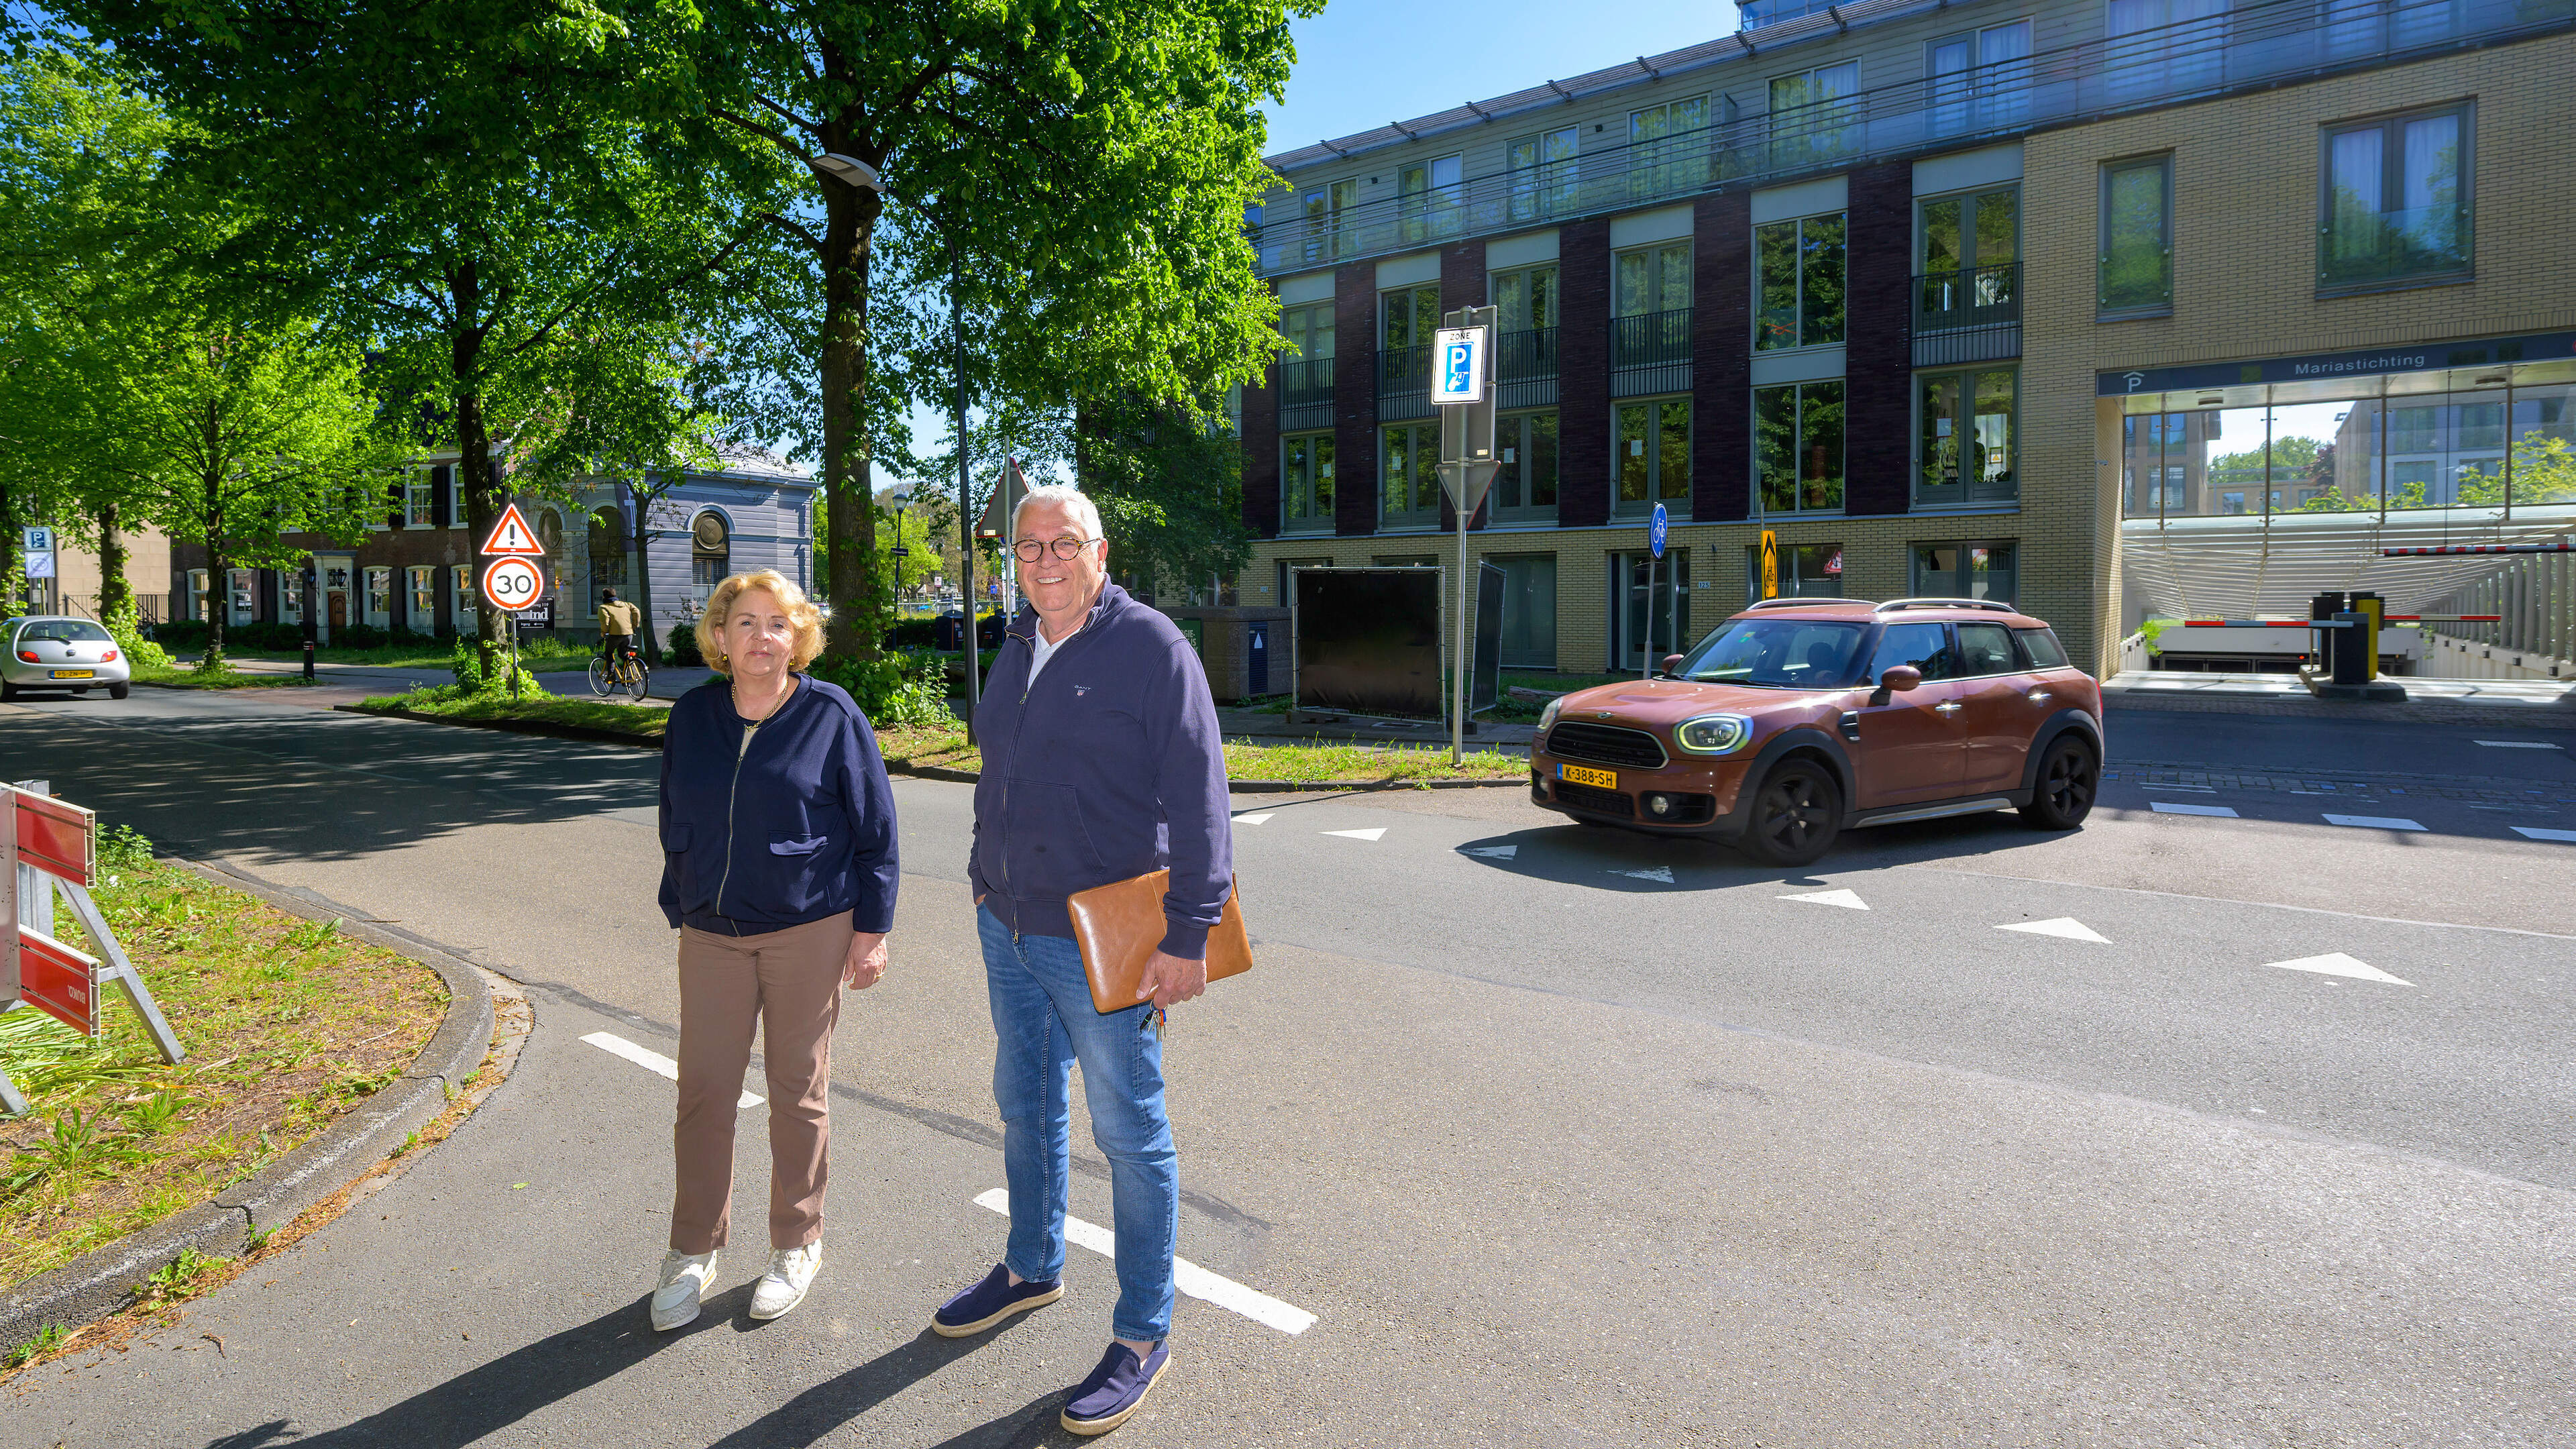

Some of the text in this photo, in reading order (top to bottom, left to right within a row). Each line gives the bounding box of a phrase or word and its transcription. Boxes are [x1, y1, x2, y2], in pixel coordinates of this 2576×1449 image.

[1450, 332, 1470, 341] ZONE
[1450, 347, 1467, 374] P
[2127, 355, 2426, 392] P Mariastichting
[33, 532, 43, 542] P
[496, 575, 531, 594] 30
[1565, 767, 1613, 787] K-388-SH
